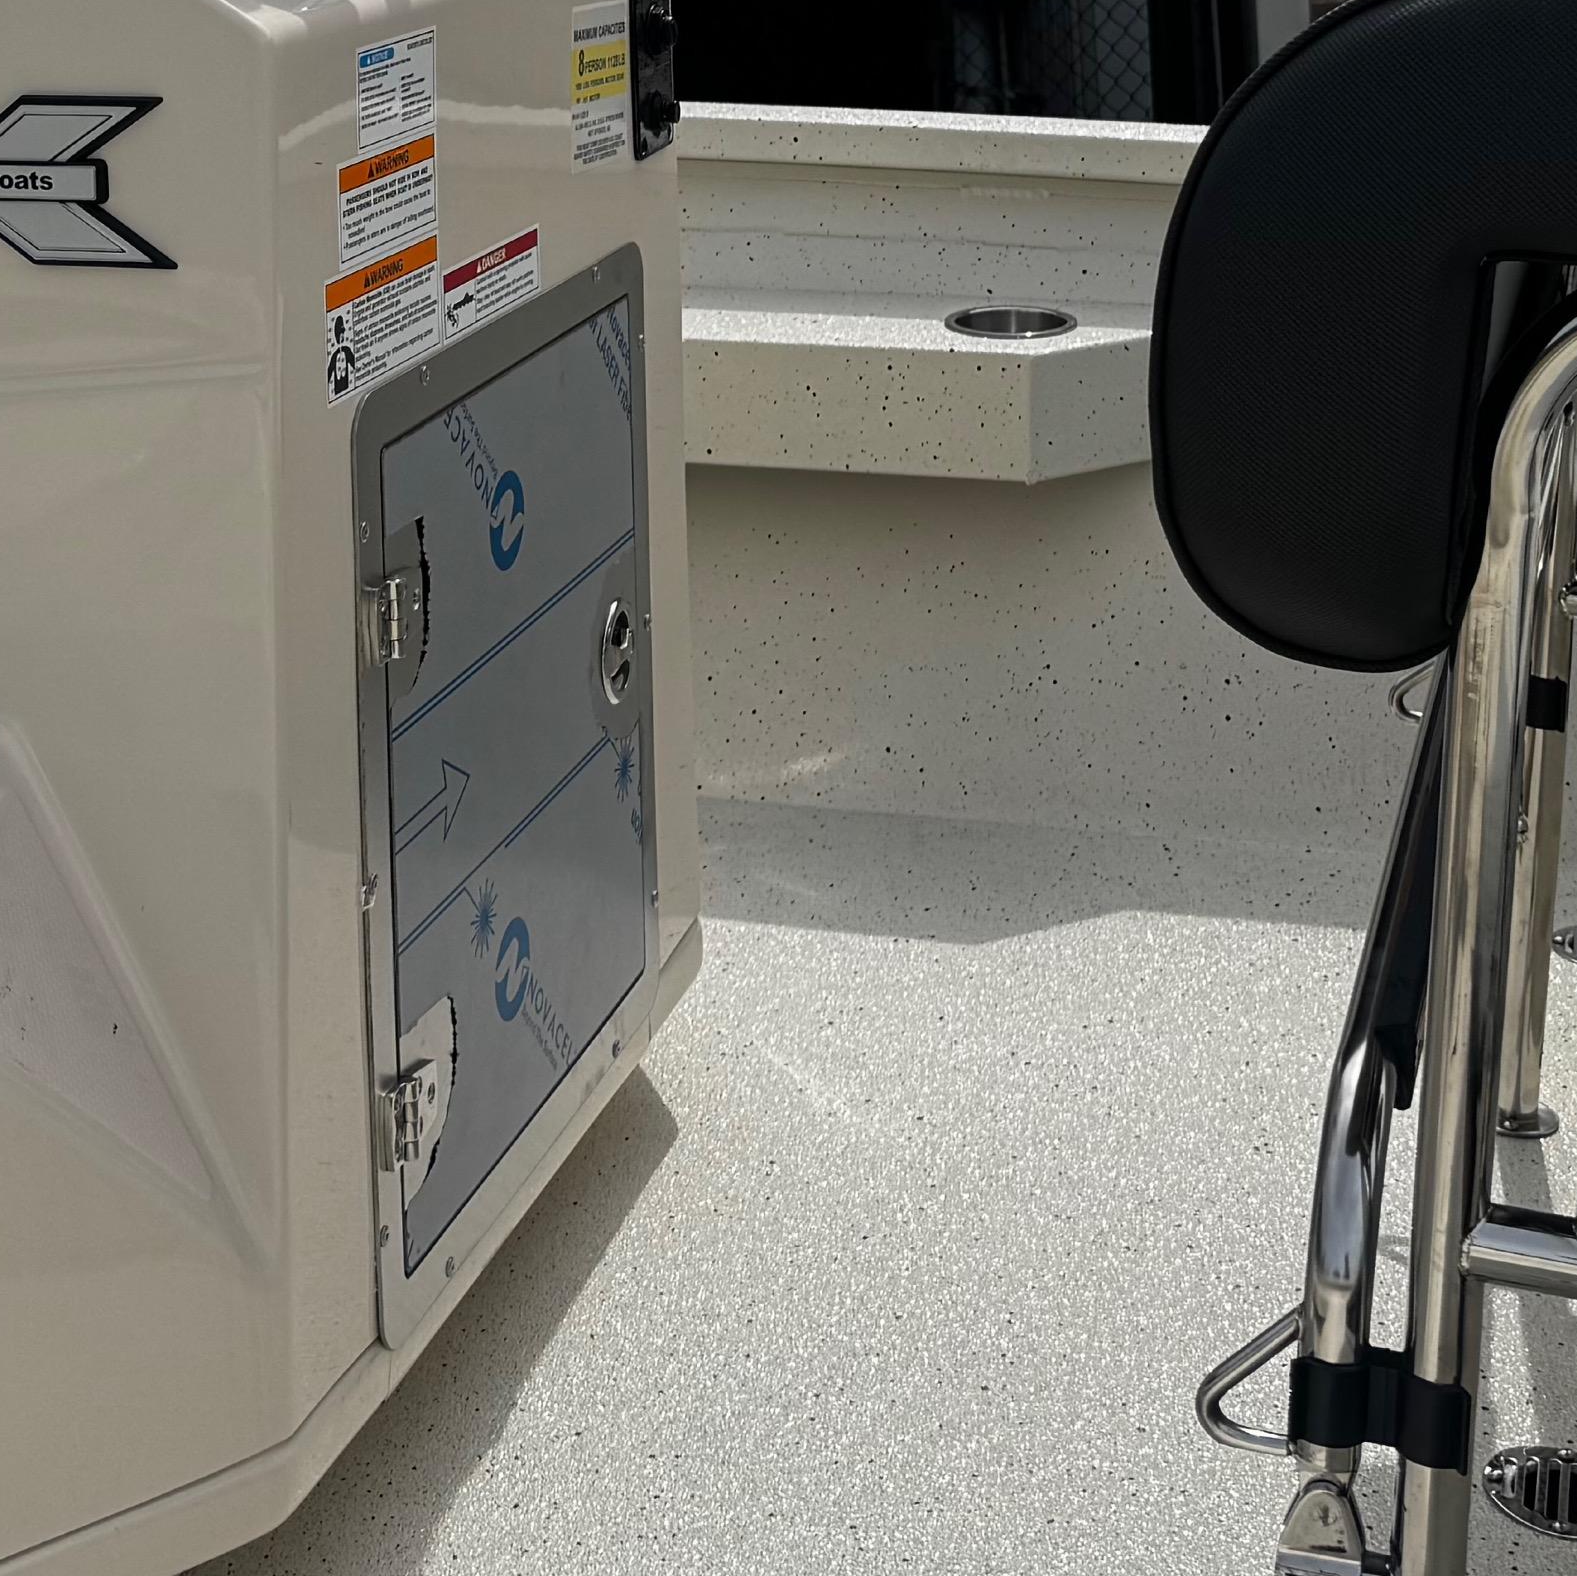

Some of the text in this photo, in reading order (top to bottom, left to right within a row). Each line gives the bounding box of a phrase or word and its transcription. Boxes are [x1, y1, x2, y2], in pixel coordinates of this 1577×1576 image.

[578, 49, 585, 77] 8
[374, 149, 409, 175] WARNING
[369, 258, 404, 286] WARNING
[482, 247, 506, 271] DANGER
[526, 971, 574, 1067] NOVACEL
